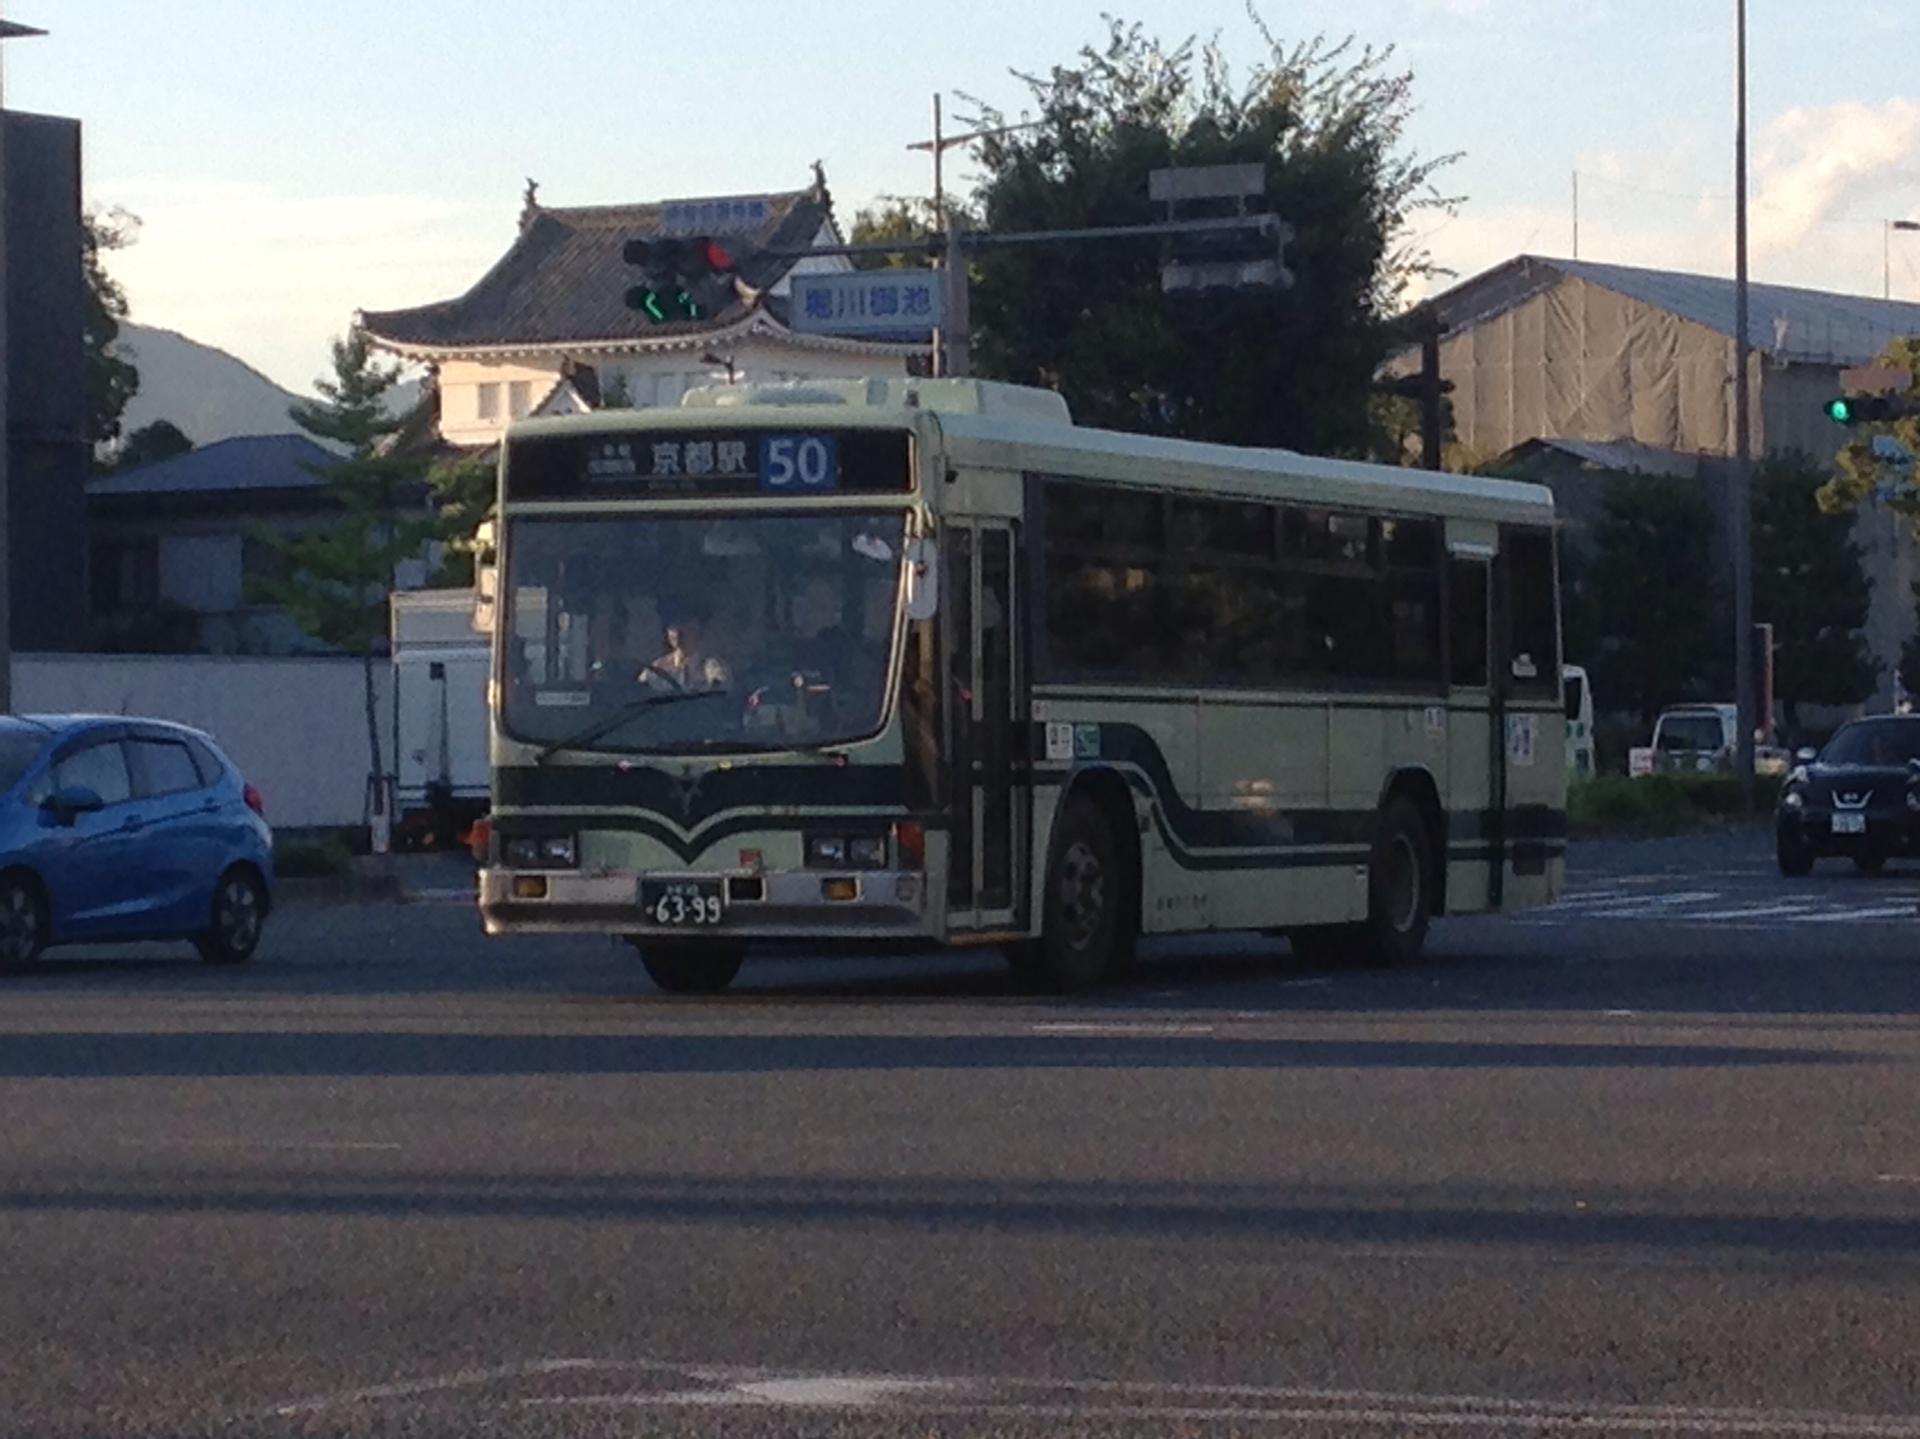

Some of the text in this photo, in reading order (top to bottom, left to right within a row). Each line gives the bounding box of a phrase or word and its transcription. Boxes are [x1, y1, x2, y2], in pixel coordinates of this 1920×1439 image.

[652, 440, 747, 474] 京都駅
[768, 437, 827, 485] 50
[656, 895, 721, 923] 63-99
